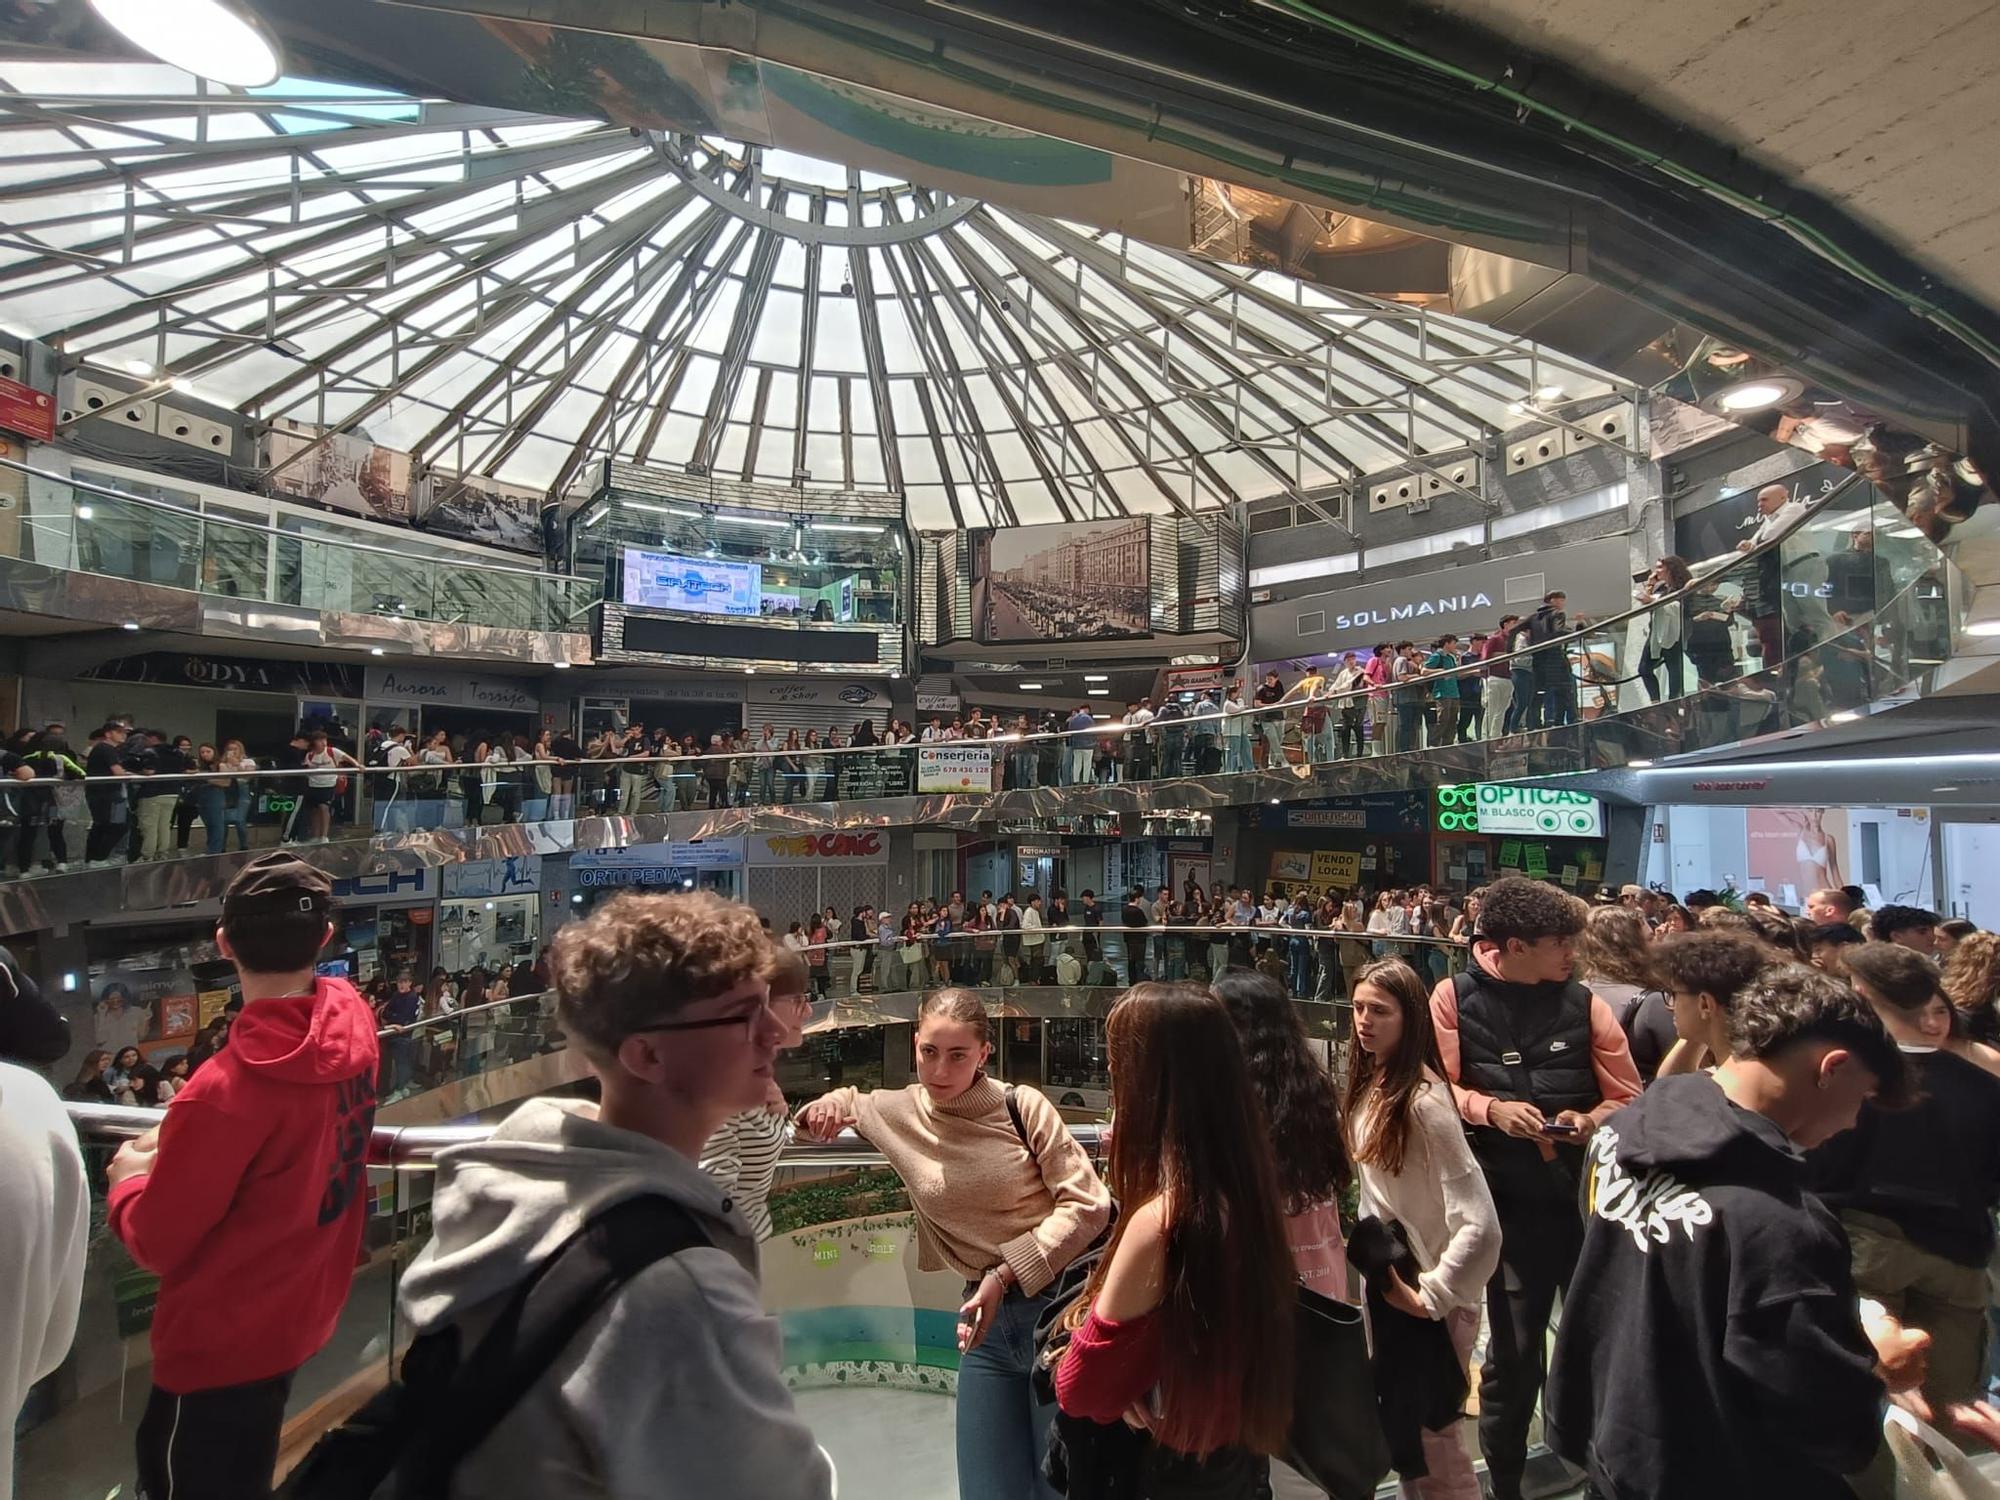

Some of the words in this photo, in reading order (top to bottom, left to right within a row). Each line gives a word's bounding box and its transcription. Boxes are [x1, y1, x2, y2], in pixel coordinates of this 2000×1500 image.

[1335, 592, 1492, 630] SOLMANIA
[382, 673, 448, 697] Aurora
[469, 681, 526, 708] Torrijo
[920, 749, 990, 762] Conserjería
[1480, 808, 1489, 817] M.
[1491, 808, 1535, 818] BLASCO
[1317, 854, 1354, 865] VENDO
[580, 868, 683, 886] ORTOPEDIA
[1317, 866, 1351, 877] LOCAL
[814, 1249, 839, 1260] MINI
